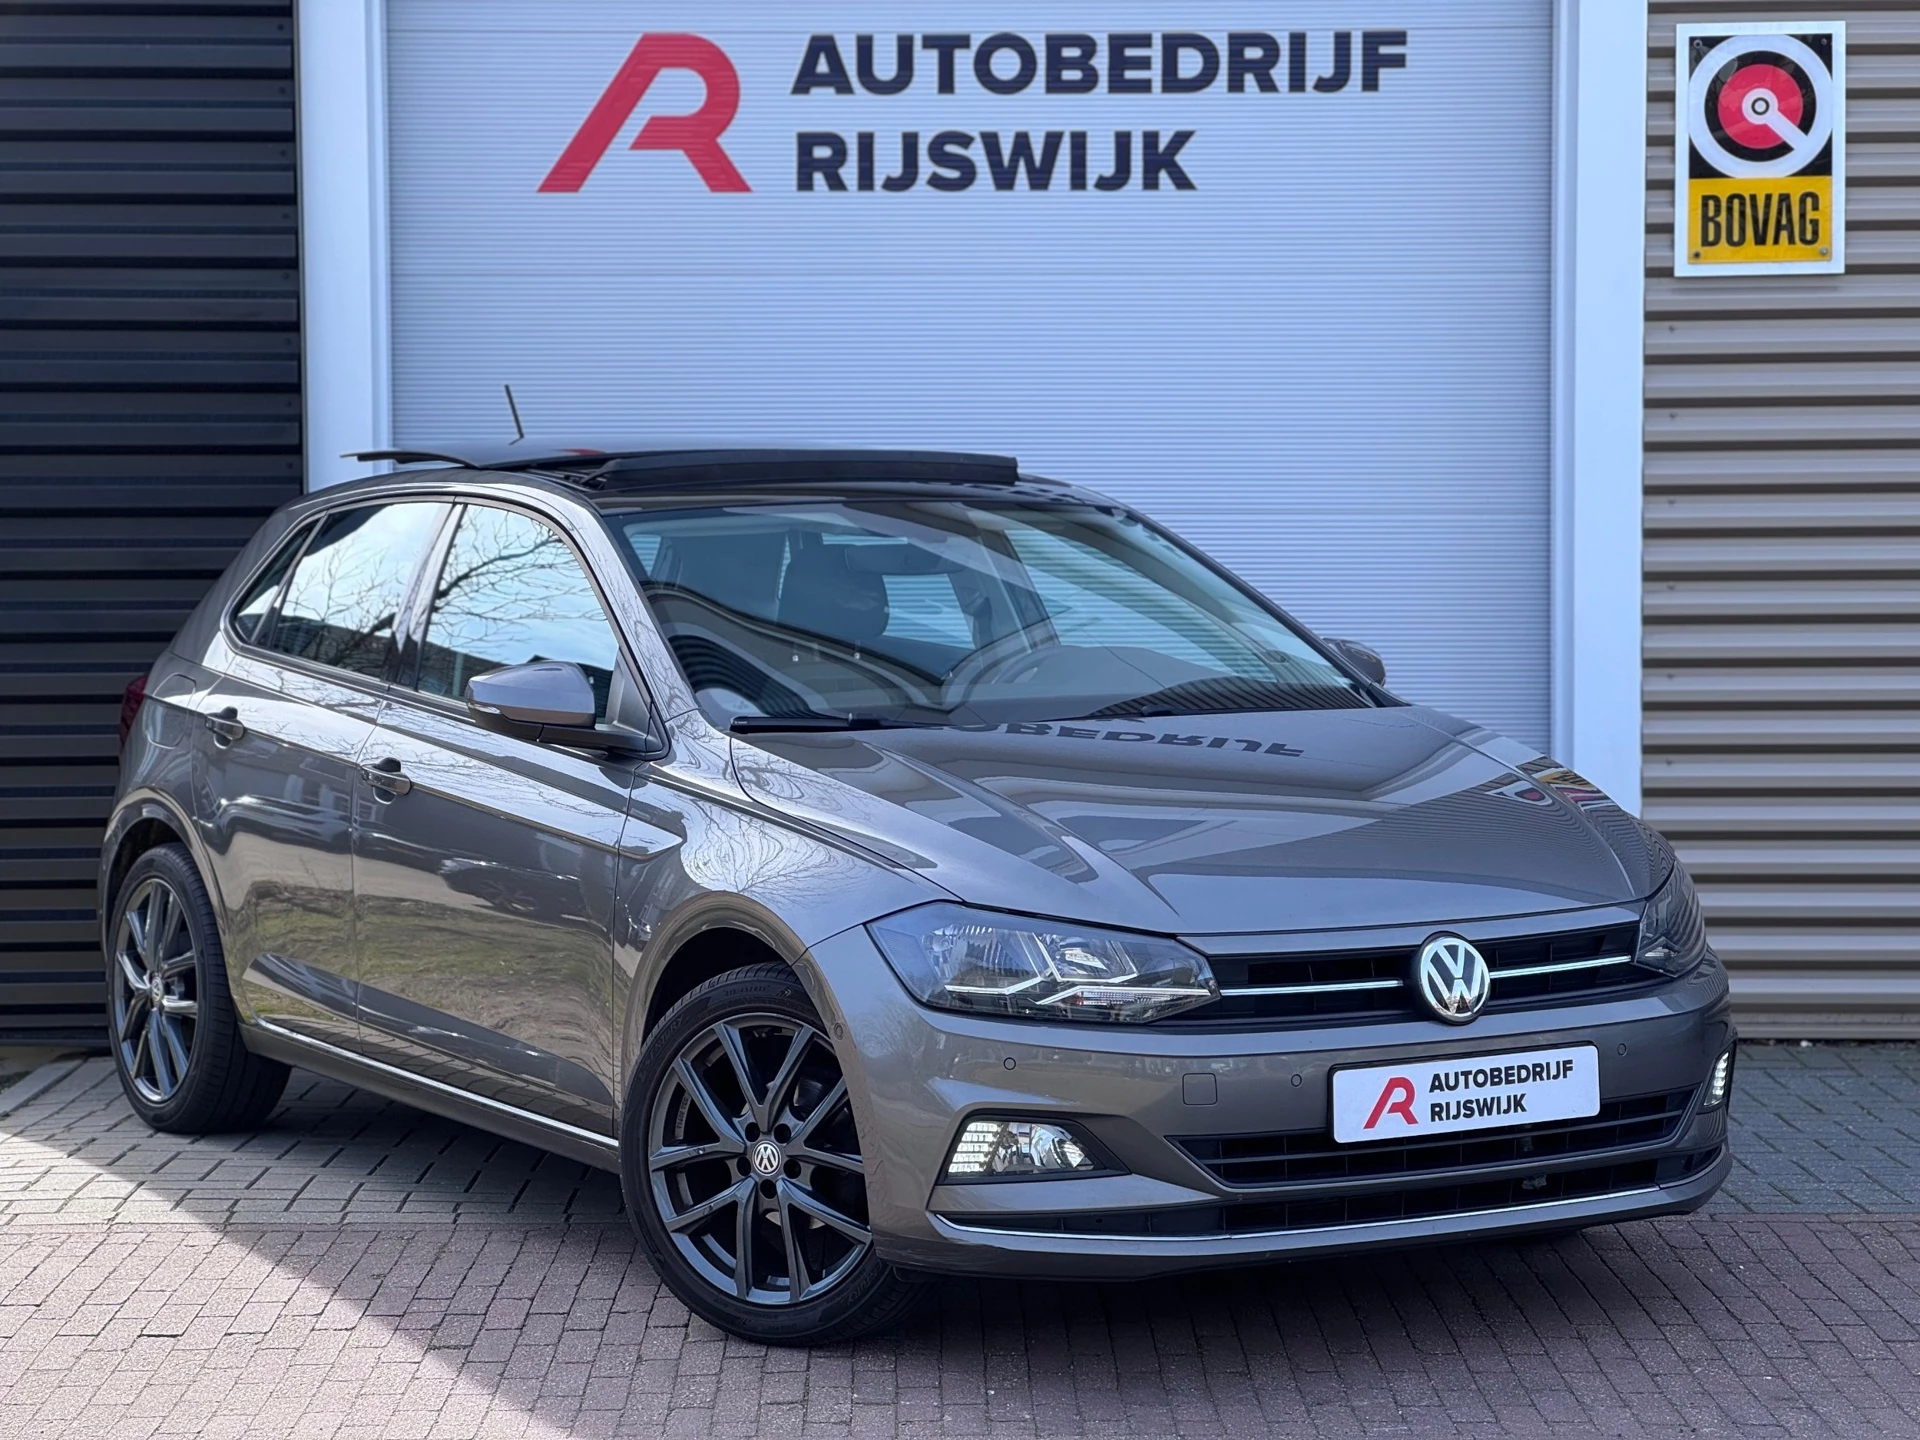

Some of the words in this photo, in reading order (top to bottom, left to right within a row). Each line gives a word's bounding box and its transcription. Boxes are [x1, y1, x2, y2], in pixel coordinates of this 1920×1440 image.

[791, 31, 1408, 96] AUTOBEDRIJF
[797, 131, 1198, 193] RIJSWIJK
[1700, 191, 1820, 248] BOVAG
[1429, 1059, 1574, 1093] AUTOBEDRIJF
[1430, 1093, 1527, 1122] RIJSWIJK
